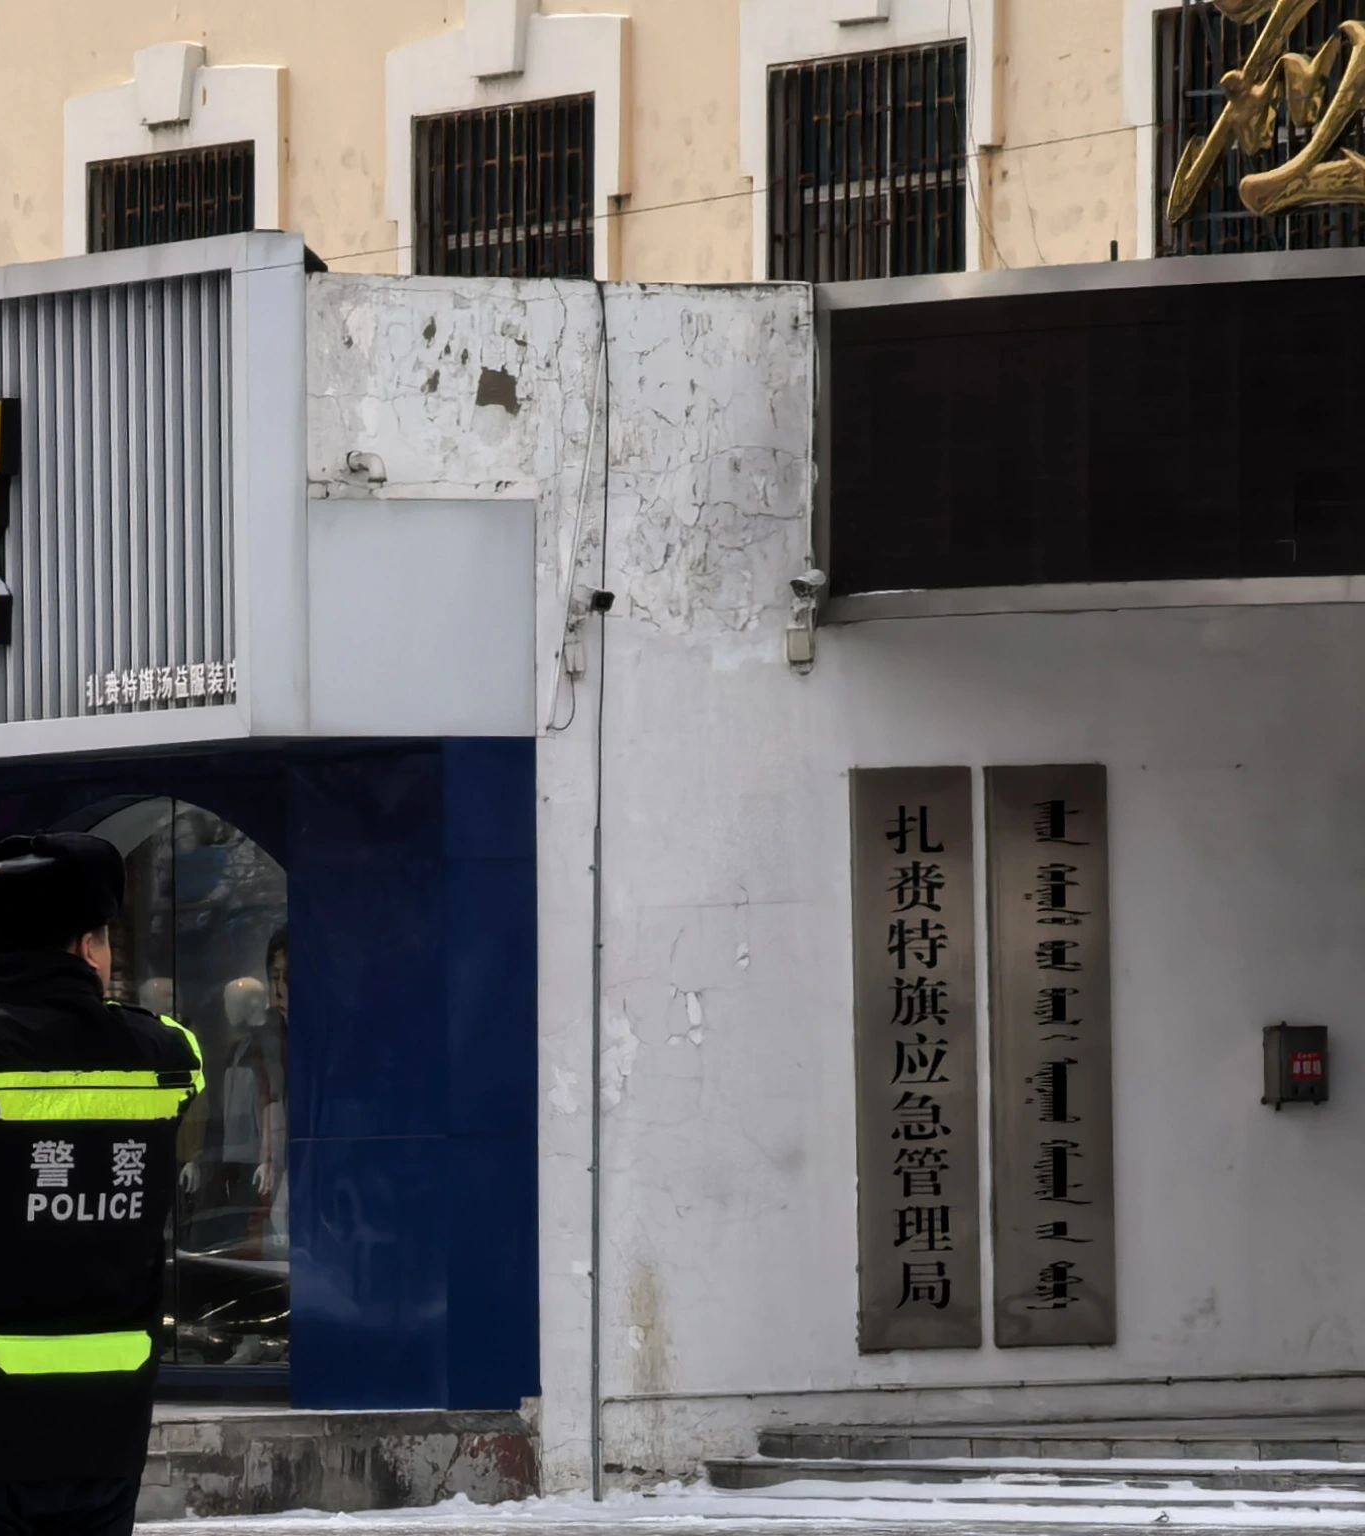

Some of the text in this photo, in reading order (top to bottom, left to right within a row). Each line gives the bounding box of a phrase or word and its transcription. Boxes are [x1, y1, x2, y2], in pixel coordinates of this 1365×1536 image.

[885, 804, 953, 1310] 扎赉特旗应急管理局
[27, 1191, 144, 1222] POLICE
